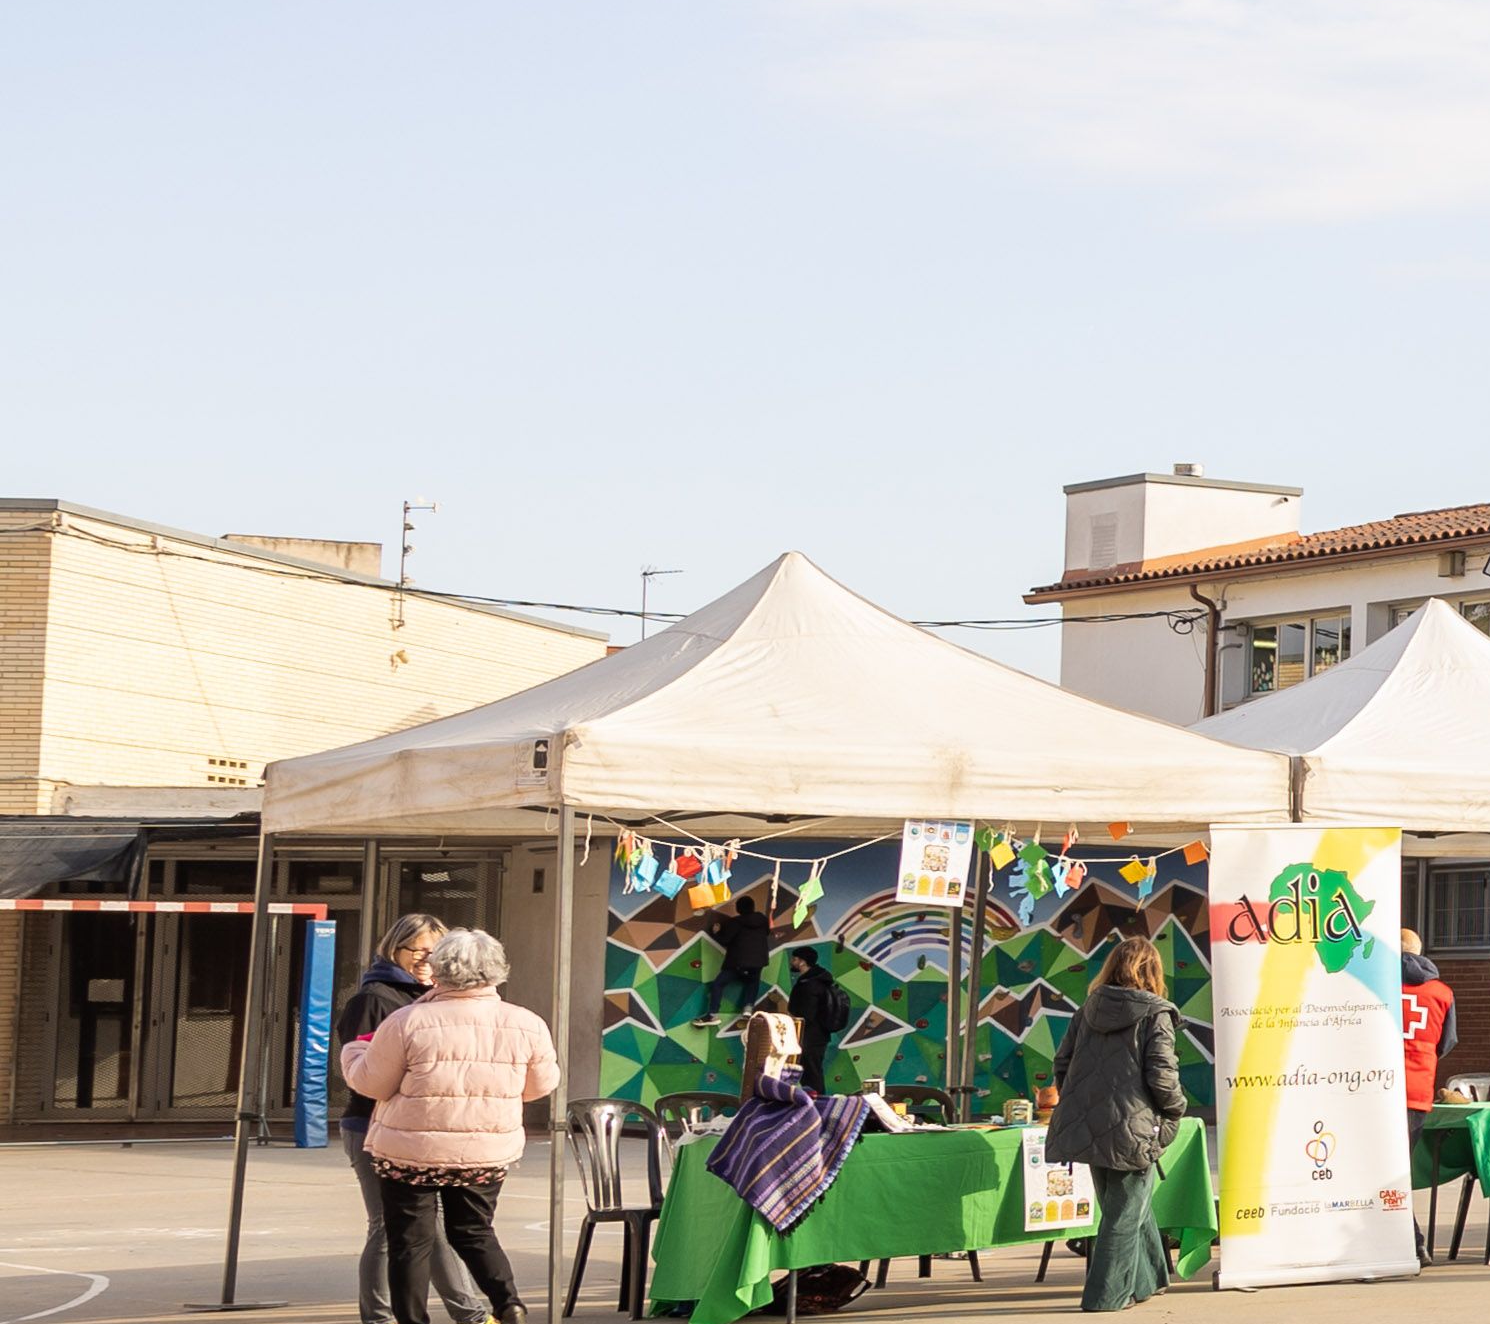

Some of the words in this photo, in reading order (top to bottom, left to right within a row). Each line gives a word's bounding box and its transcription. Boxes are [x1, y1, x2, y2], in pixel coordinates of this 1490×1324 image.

[1227, 872, 1363, 946] adia
[1220, 1004, 1273, 1018] Associació
[1273, 1006, 1290, 1018] per
[1294, 1004, 1302, 1015] al
[1305, 1000, 1389, 1016] Desenvolupament
[1252, 1019, 1263, 1030] de
[1266, 1018, 1276, 1029] la
[1225, 1064, 1396, 1093] www.adia-ong.org
[1311, 1168, 1333, 1181] ceb
[1379, 1189, 1397, 1199] CAN
[1235, 1206, 1265, 1221] ceeb
[1271, 1204, 1321, 1218] Fundació
